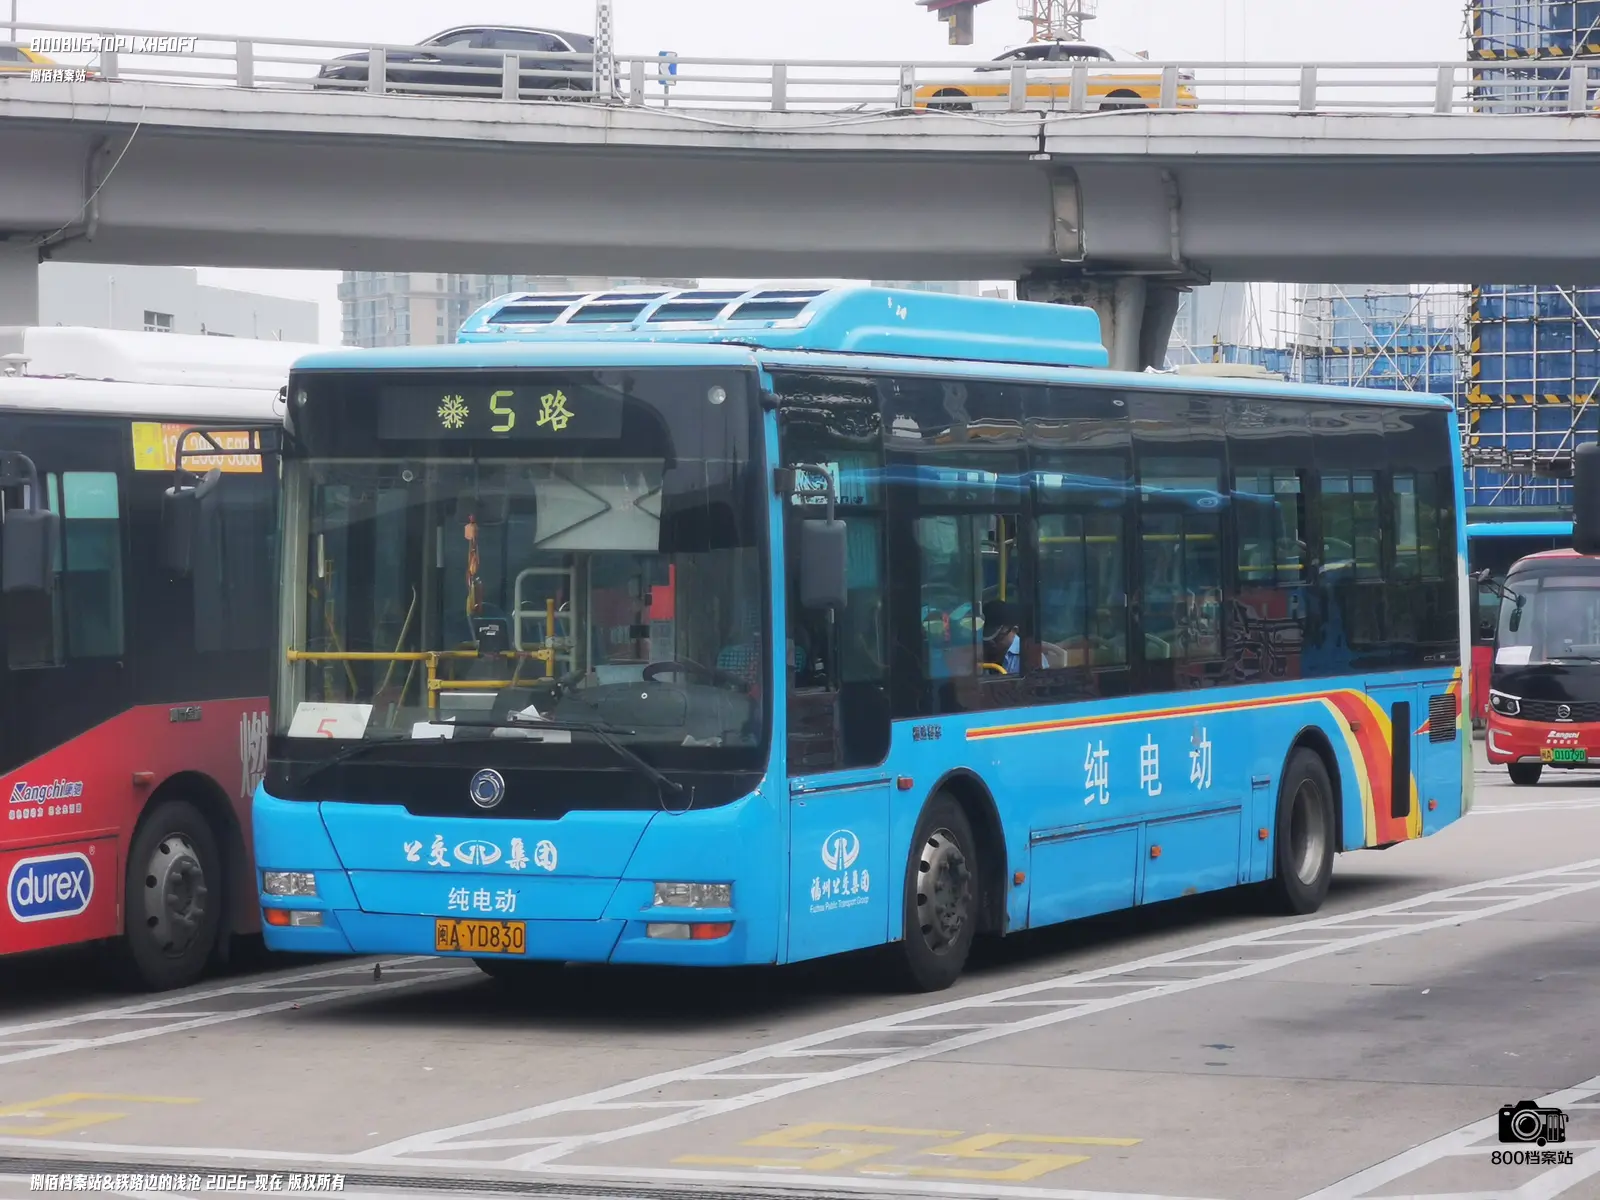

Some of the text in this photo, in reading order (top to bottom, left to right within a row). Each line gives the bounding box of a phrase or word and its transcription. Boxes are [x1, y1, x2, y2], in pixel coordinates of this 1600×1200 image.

[489, 390, 575, 432] 5 路
[316, 718, 338, 738] 5
[1084, 727, 1212, 806] 纯电动
[403, 834, 558, 871] 公交 集团
[16, 867, 85, 907] durex
[447, 887, 517, 913] 纯电动
